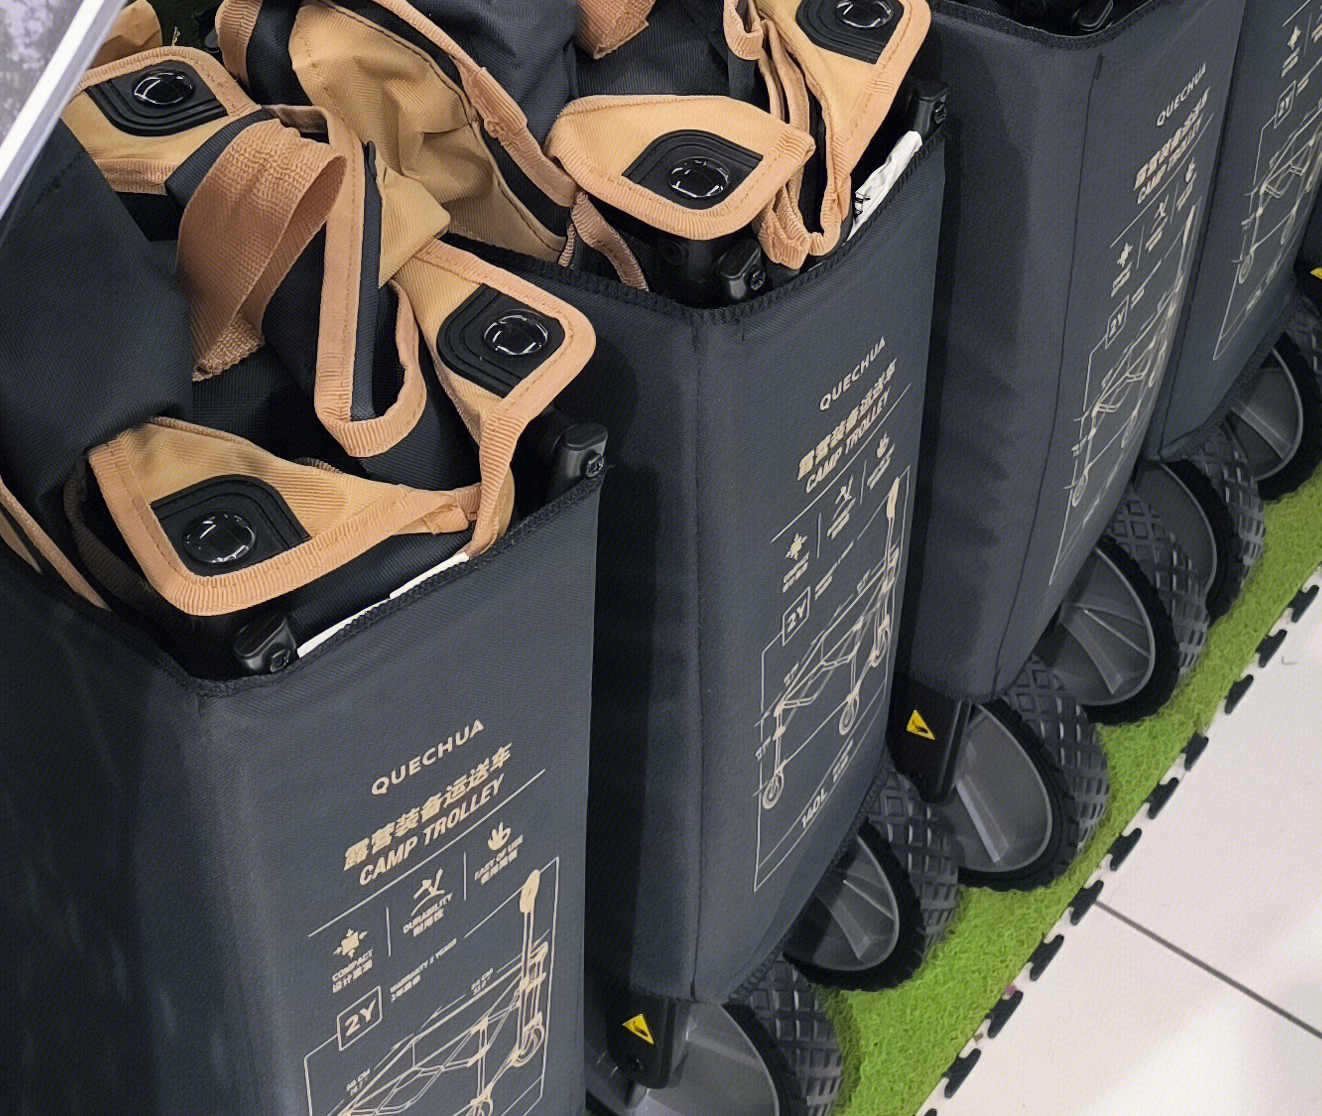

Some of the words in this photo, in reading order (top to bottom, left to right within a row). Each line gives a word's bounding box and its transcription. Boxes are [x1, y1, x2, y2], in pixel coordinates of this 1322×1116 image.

[1156, 62, 1206, 127] QUECHUA
[819, 336, 886, 411] QUECHUA
[371, 719, 485, 795] QUECHUA
[359, 835, 418, 886] CAMP
[423, 772, 505, 845] TROLLEY
[403, 892, 453, 934] DURABILITY
[331, 948, 374, 982] COMPACT
[343, 998, 377, 1037] 2Y
